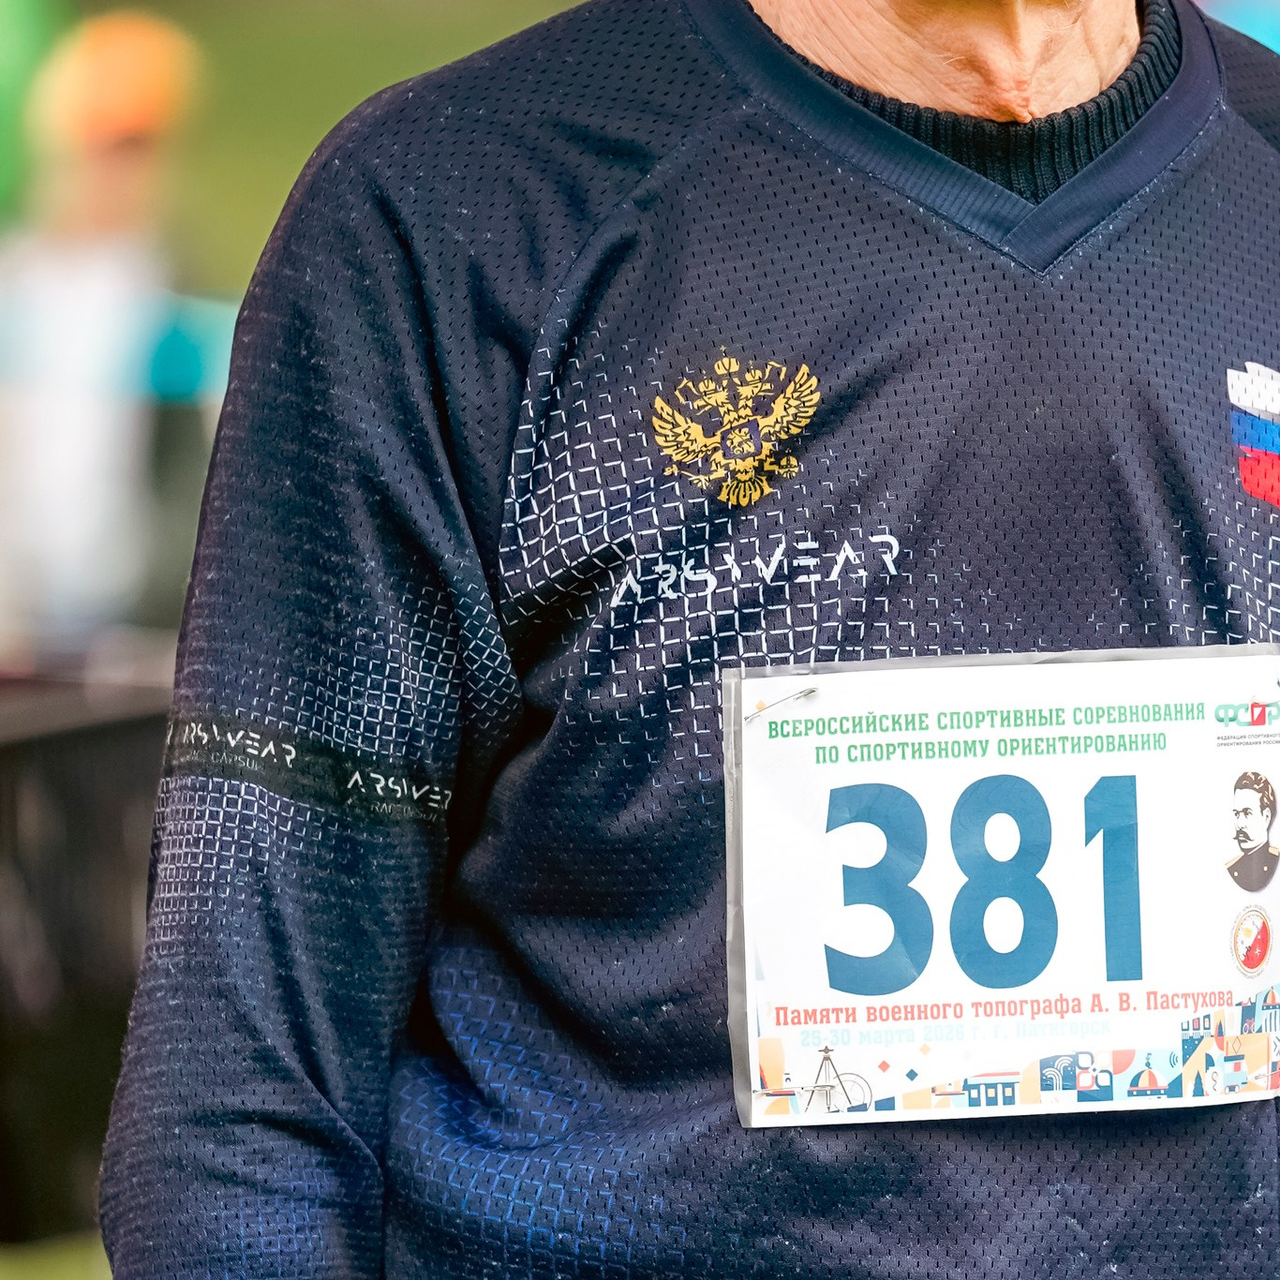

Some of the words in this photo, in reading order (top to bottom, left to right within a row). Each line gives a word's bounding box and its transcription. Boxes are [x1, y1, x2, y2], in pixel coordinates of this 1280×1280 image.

[768, 711, 929, 739] ВСЕРОССИЙСКИЕ
[937, 707, 1066, 730] СПОРТИВНЫЕ
[1073, 702, 1206, 725] СОРЕВНОВАНИЯ
[815, 745, 839, 764] ПО
[847, 739, 990, 763] СПОРТИВНОМУ
[997, 732, 1167, 757] ОРИЕНТИРОВАНИЮ
[824, 774, 1143, 996] 381
[774, 1006, 857, 1026] Памяти
[866, 1002, 963, 1023] военного
[971, 993, 1082, 1020] топографа
[1090, 993, 1109, 1013] А.
[1118, 992, 1137, 1012] В.
[1146, 990, 1234, 1013] Пастухова
[801, 1028, 851, 1048] 25-30
[859, 1028, 915, 1049] марта
[923, 1024, 964, 1043] 2026
[1016, 1020, 1111, 1040] Пятигорск
